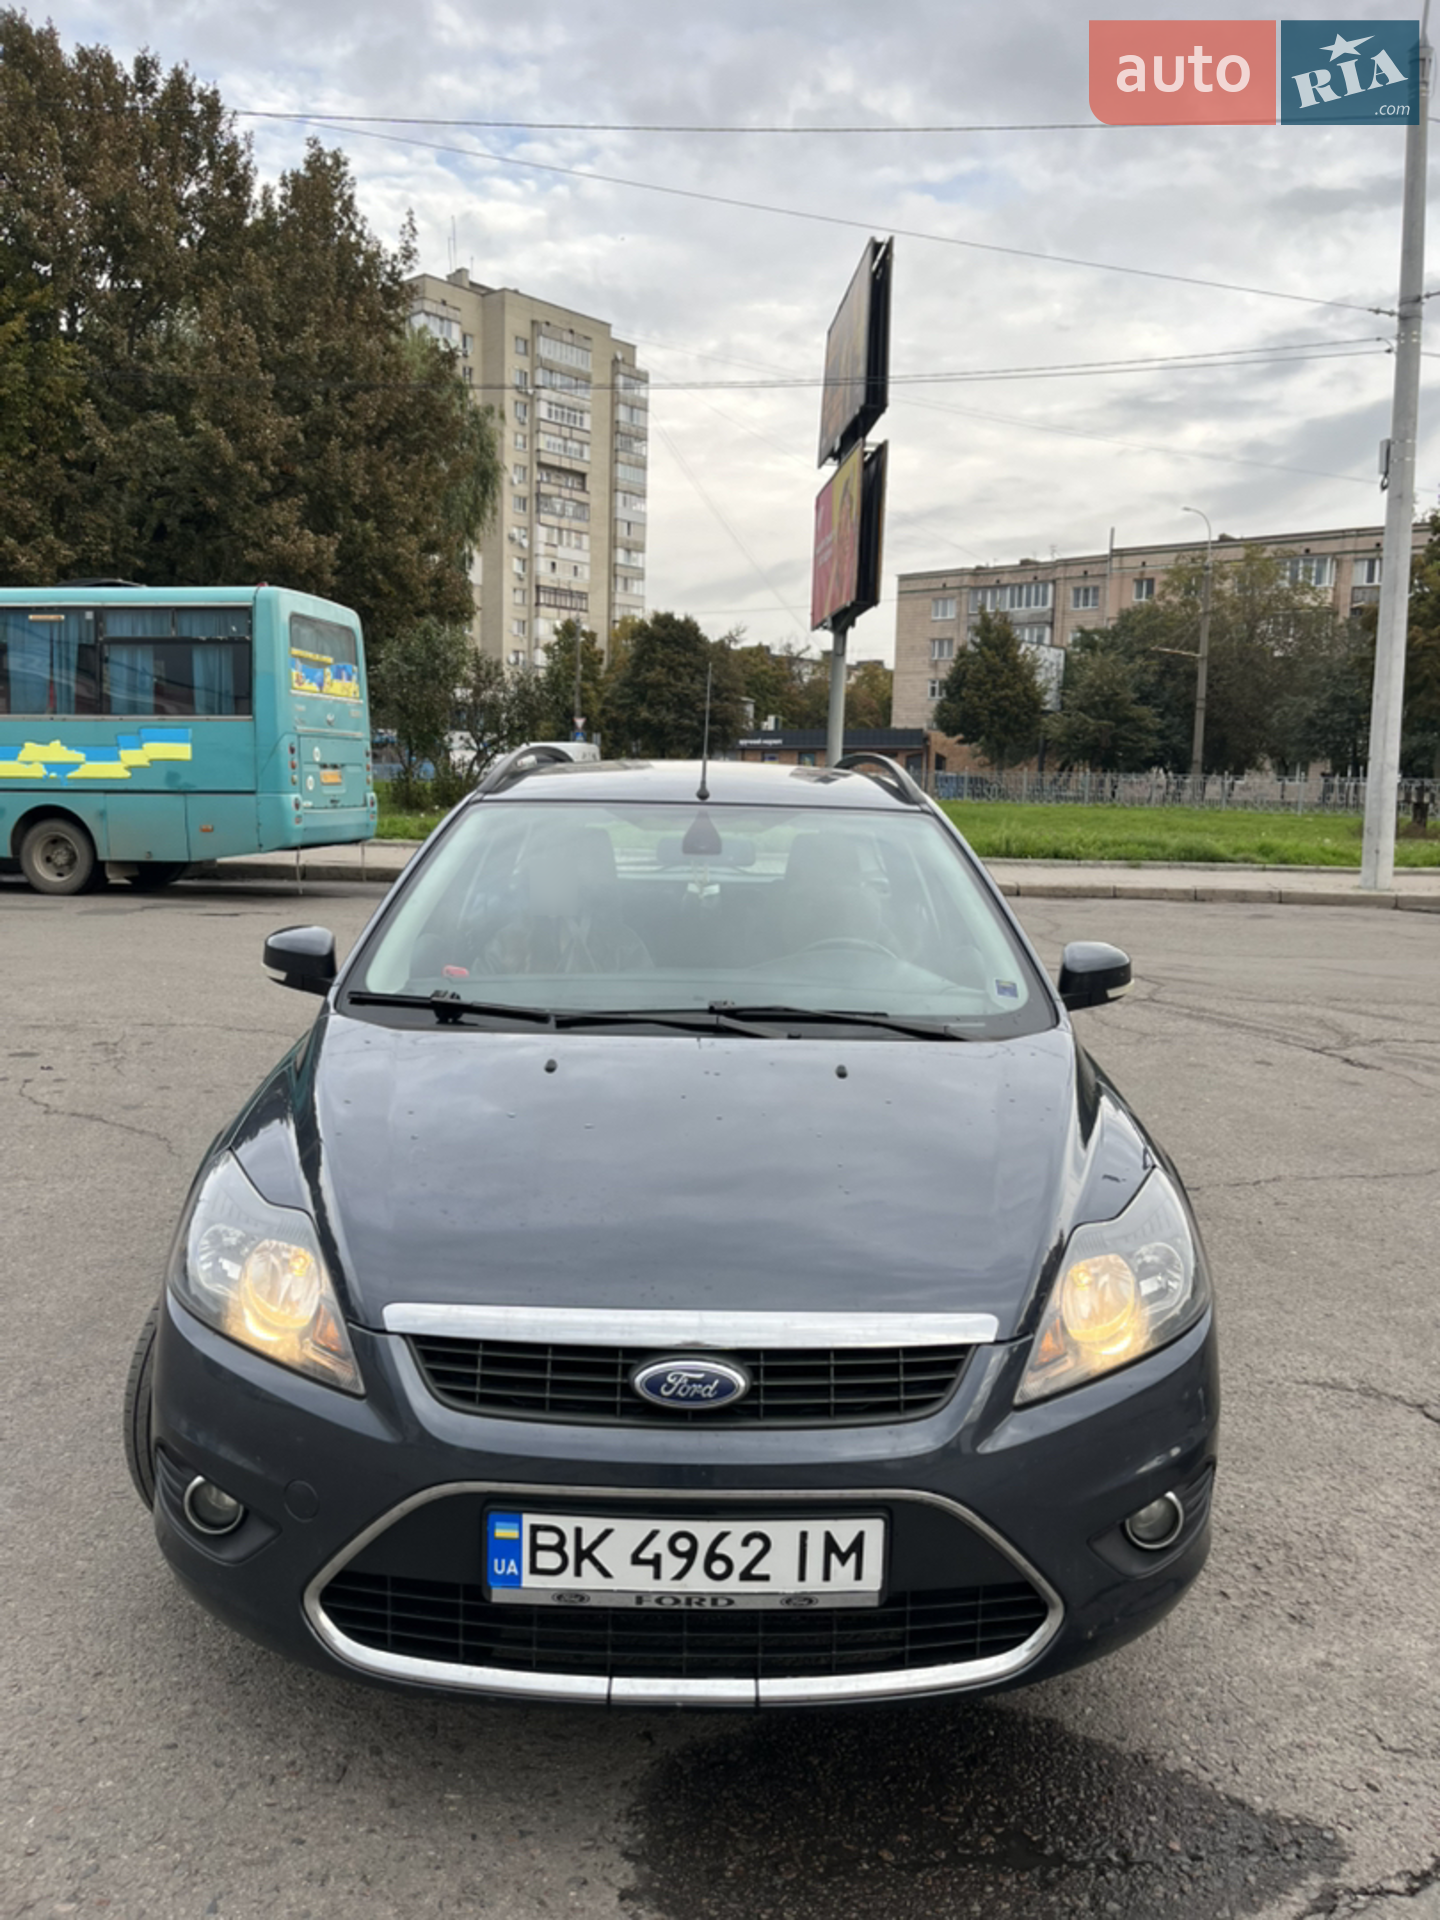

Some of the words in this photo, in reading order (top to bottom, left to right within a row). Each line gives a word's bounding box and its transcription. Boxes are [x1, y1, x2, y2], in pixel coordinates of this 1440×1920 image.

[660, 1371, 719, 1397] Ford
[529, 1523, 615, 1578] BK
[630, 1529, 772, 1582] 4962
[797, 1529, 865, 1582] IM
[493, 1557, 519, 1576] UA
[635, 1594, 736, 1608] FORD
